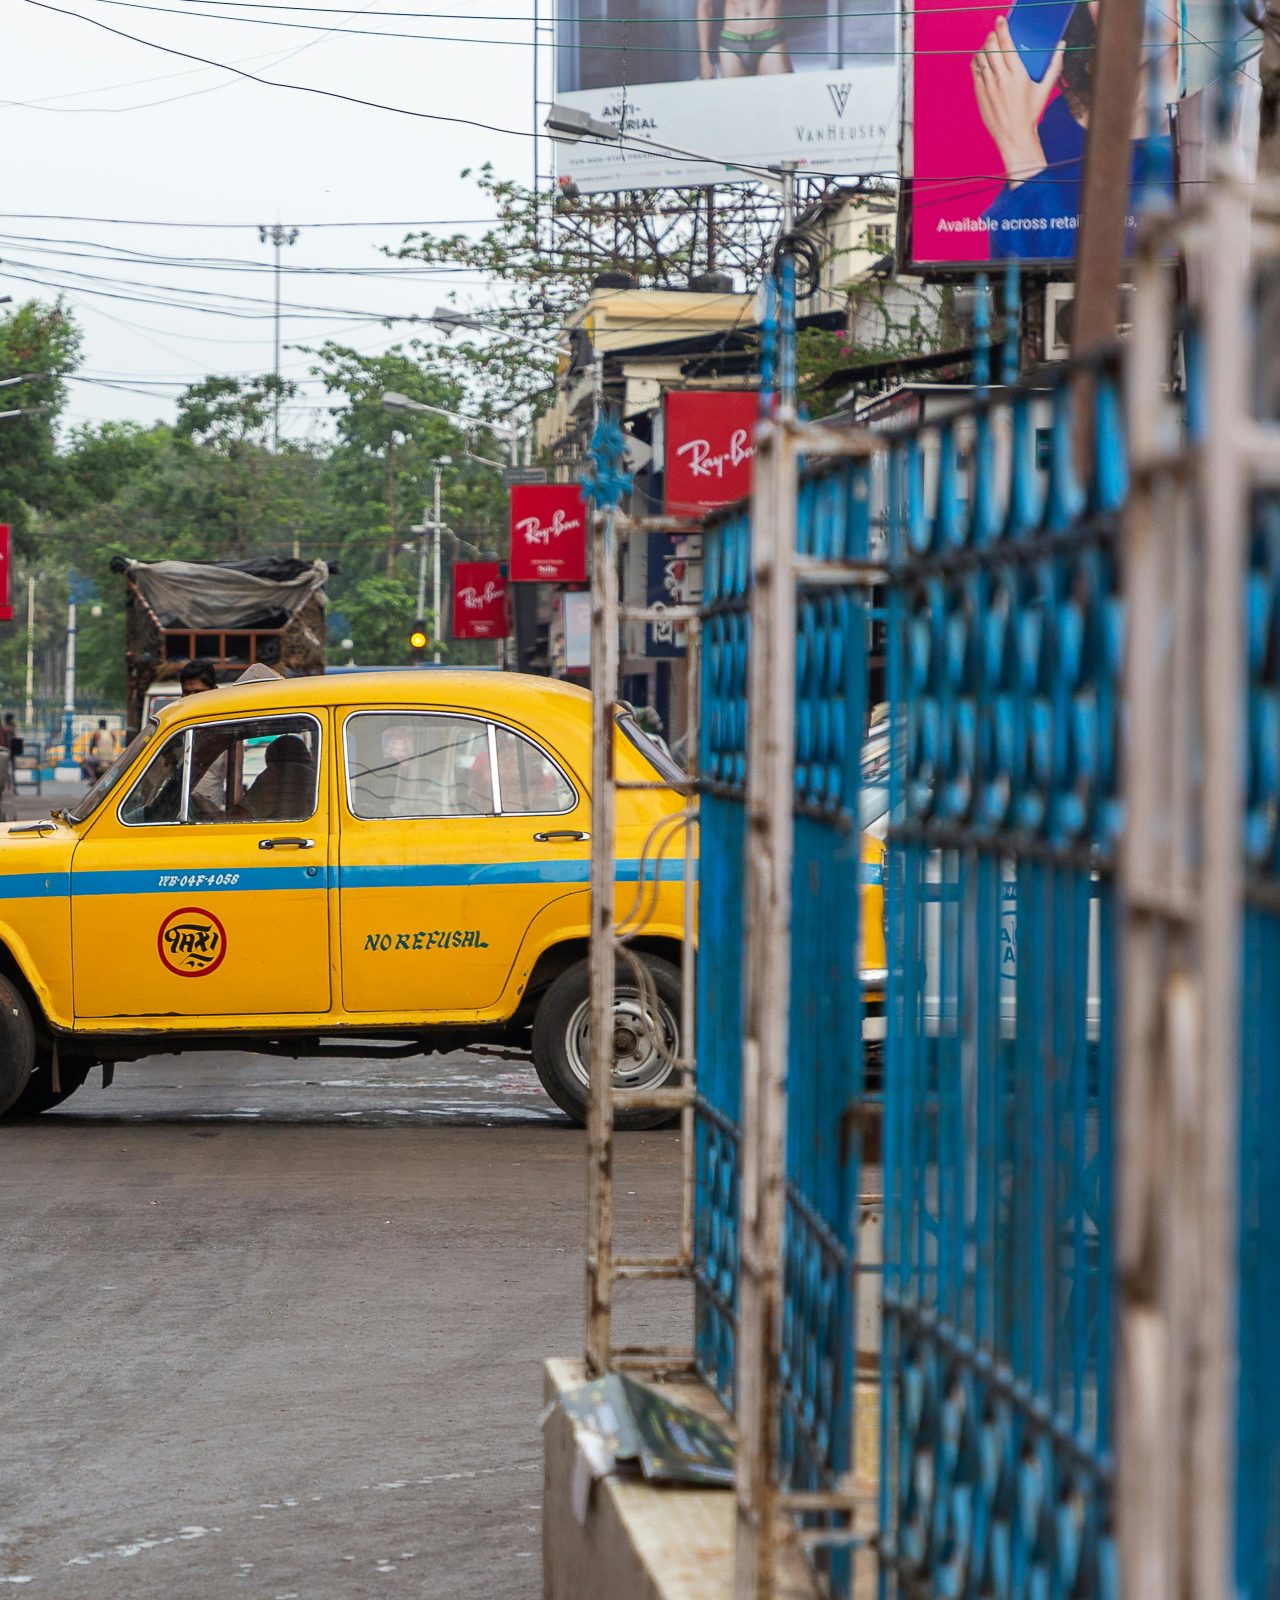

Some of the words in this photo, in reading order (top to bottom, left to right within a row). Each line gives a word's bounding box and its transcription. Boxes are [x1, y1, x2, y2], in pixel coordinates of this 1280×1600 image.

[936, 217, 999, 233] Available
[1001, 216, 1048, 231] across
[1050, 214, 1081, 230] retai
[676, 429, 757, 478] Ray-Ba
[515, 509, 582, 546] Ray-Ban
[164, 923, 219, 954] TAXI
[363, 933, 392, 952] NO
[394, 929, 490, 950] REFUSAL
